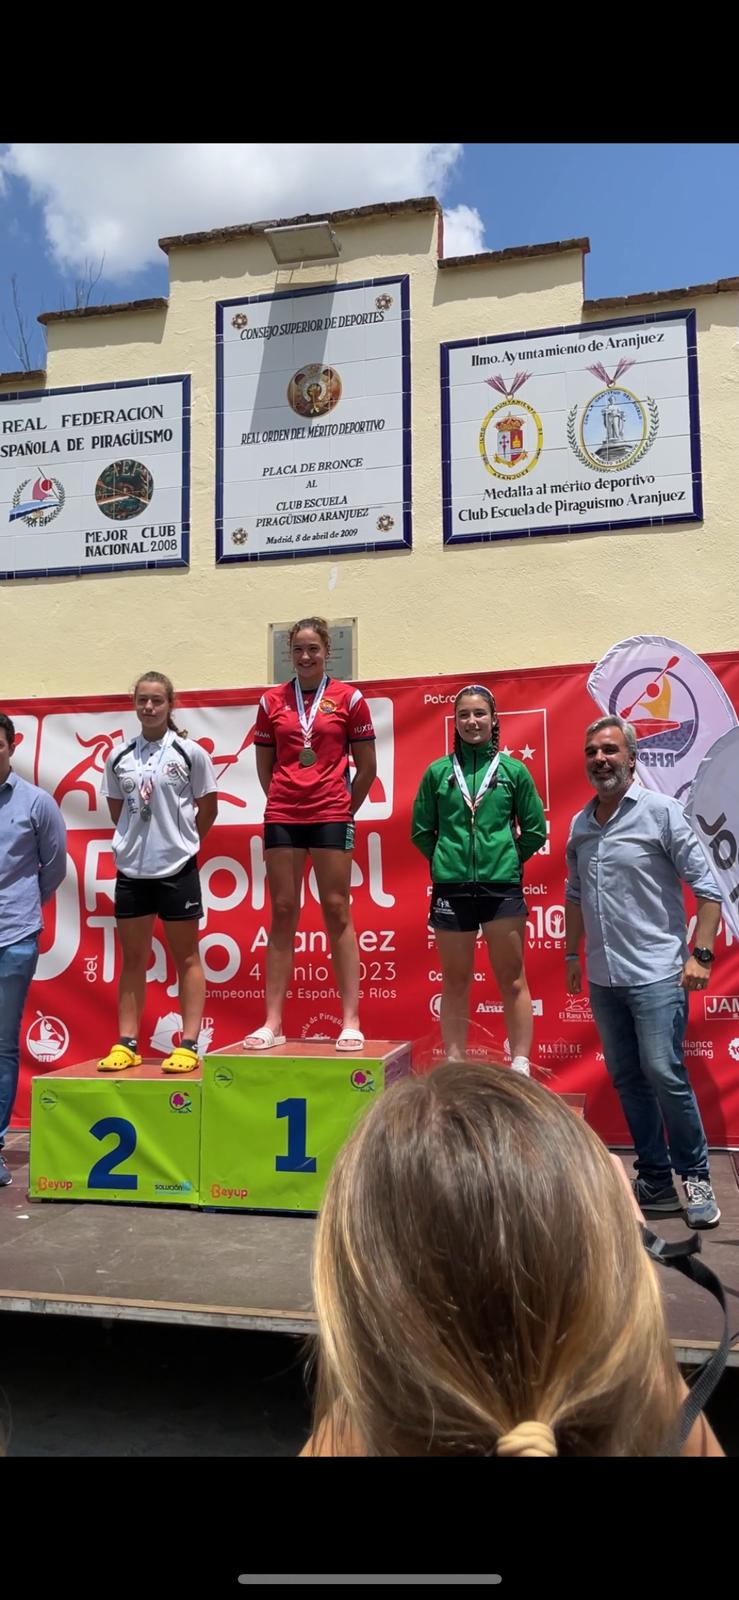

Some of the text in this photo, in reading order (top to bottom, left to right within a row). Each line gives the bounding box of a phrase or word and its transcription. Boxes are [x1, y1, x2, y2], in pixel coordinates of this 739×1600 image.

[240, 311, 385, 341] CONSEJO SUPERIOR DE DEPORTES
[500, 343, 586, 365] Ayuntamiento
[588, 339, 603, 351] de
[605, 332, 664, 352] Aranjuez
[2, 404, 164, 434] REAL FEDERACION
[241, 419, 385, 446] REAL ORDEN DEL MÉRITO DEPORTIVO
[0, 428, 173, 458] SPAÑOLA DE PIRAGÜISMO
[262, 458, 364, 477] PLACA DE BRONCE
[306, 479, 318, 489] AL
[483, 474, 655, 501] Medalla al mérito deportivo
[276, 495, 348, 512] CLUB ESCUELA
[458, 490, 686, 522] Club Escuela de Piraguismo Aranjuez
[256, 507, 369, 528] PIRAGÜISMO ARANJUEZ
[85, 525, 176, 544] MEJOR CLUB
[266, 535, 293, 545] Madrid,
[302, 532, 310, 541] de
[312, 530, 328, 540] abril
[330, 529, 339, 538] de
[340, 528, 358, 538] 2009
[85, 542, 149, 558] NACIONAL
[424, 694, 457, 704] Patro
[251, 926, 396, 960] Aanez
[84, 954, 98, 983] del
[250, 964, 261, 980] 4
[360, 962, 396, 980] 023
[204, 988, 265, 1001] ampeonat
[370, 988, 396, 998] Ríos
[276, 1098, 316, 1172] 1
[88, 1116, 138, 1190] 2
